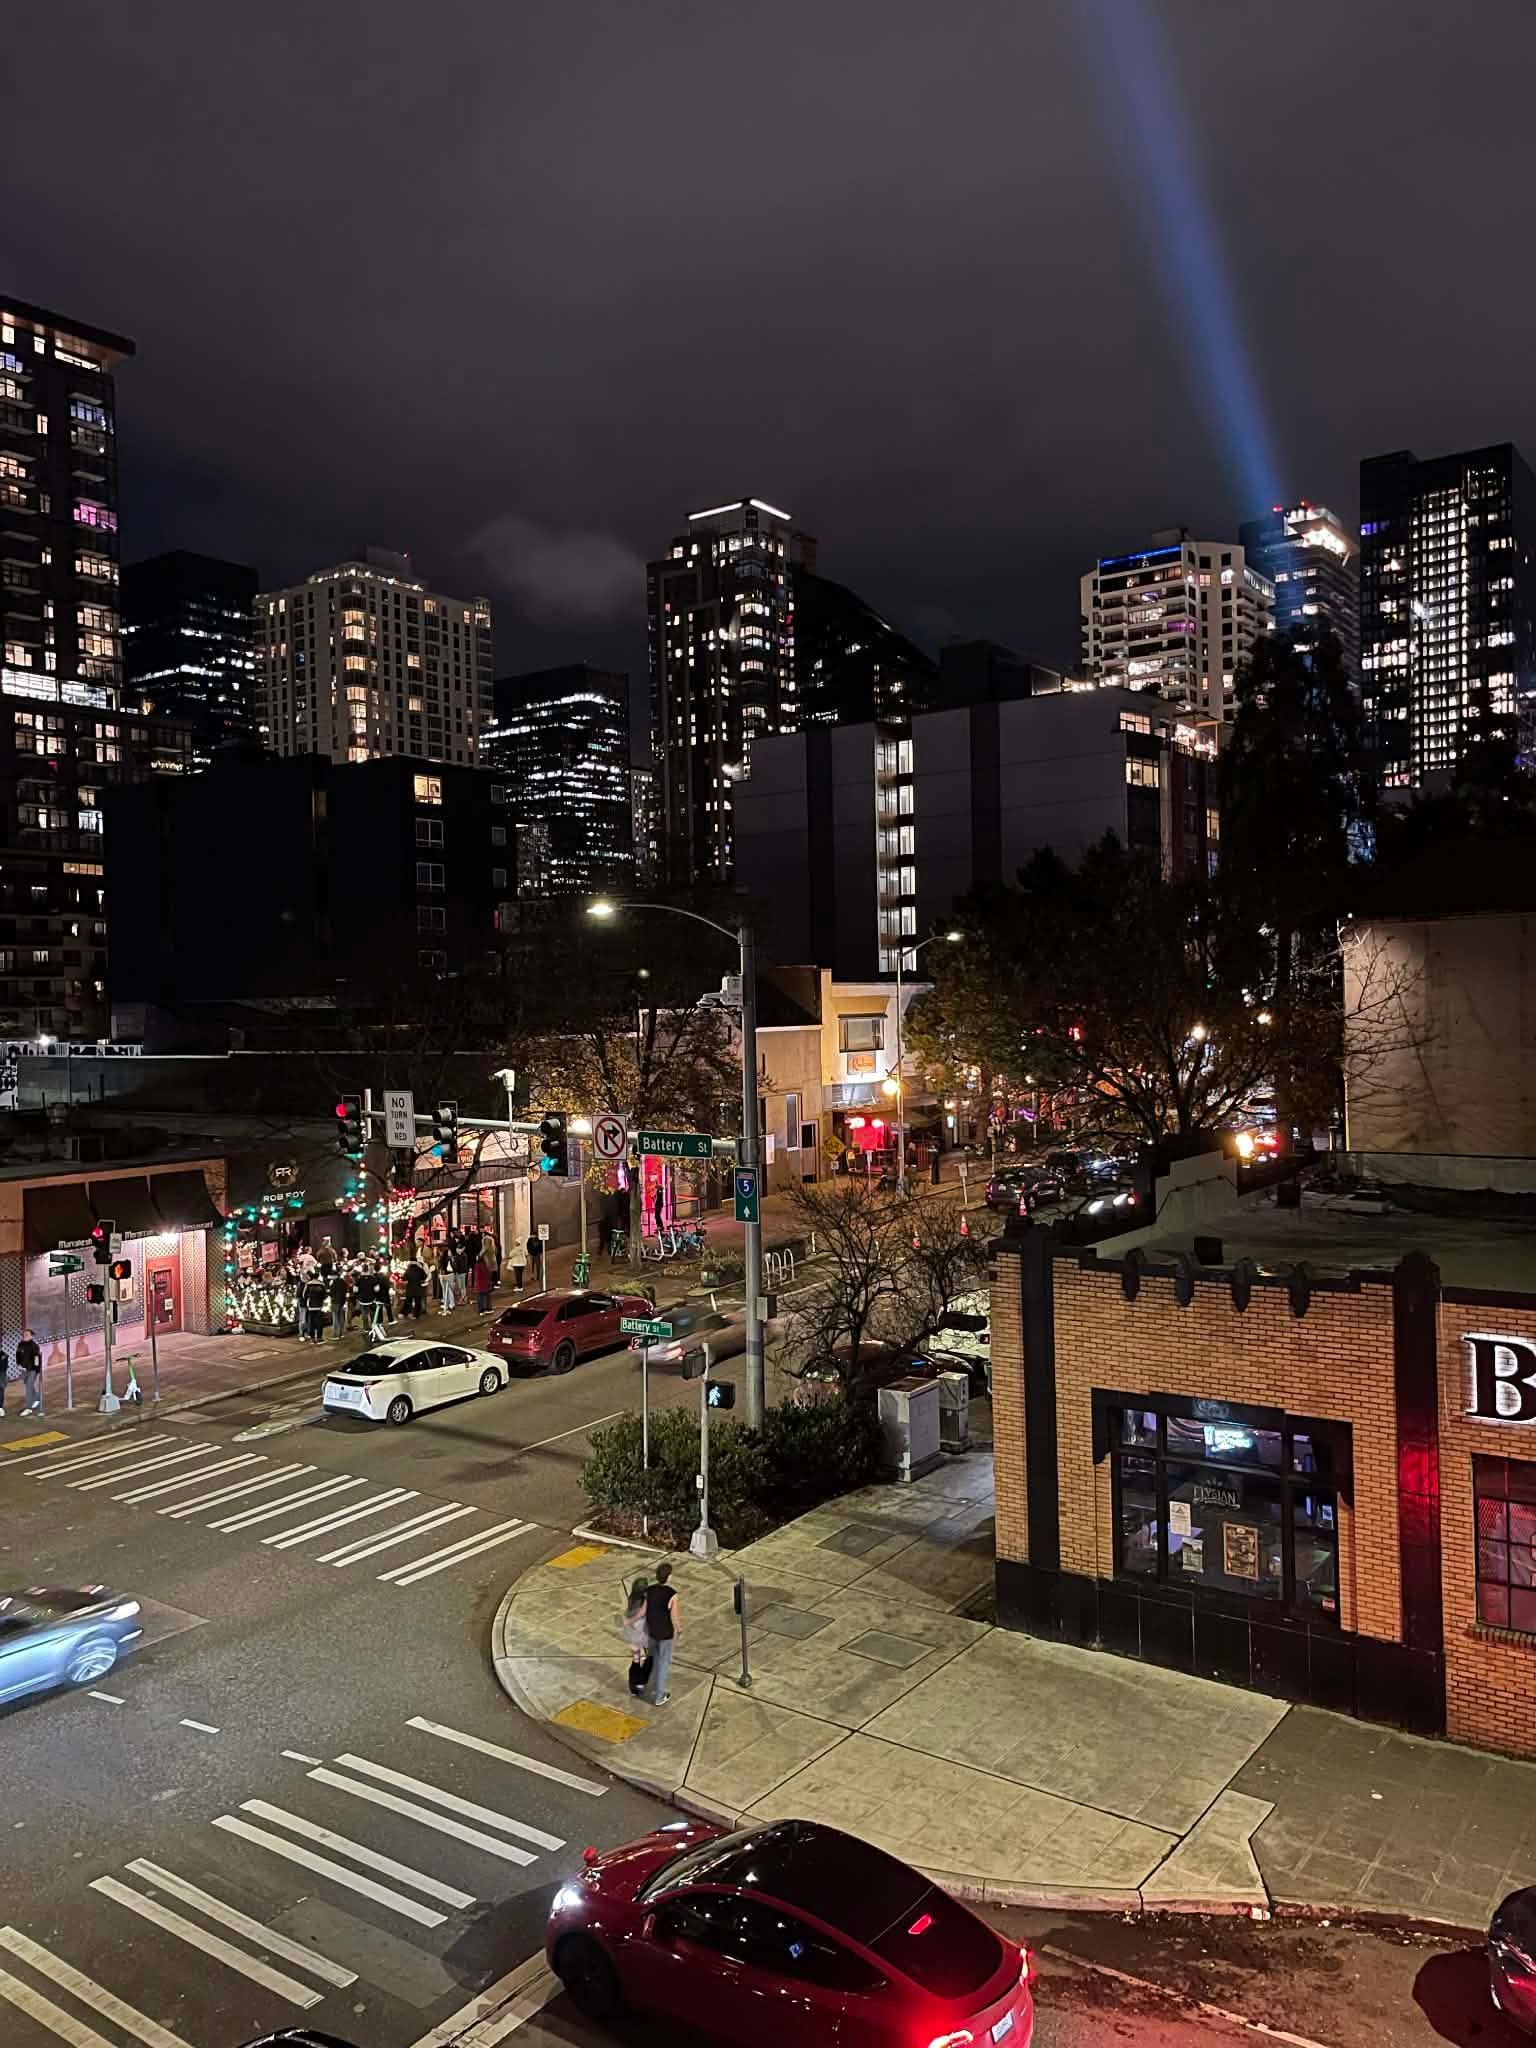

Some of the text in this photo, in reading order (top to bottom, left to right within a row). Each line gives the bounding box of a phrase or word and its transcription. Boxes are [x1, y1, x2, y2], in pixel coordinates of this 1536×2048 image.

[391, 1097, 405, 1108] NO
[391, 1110, 408, 1119] TURN
[395, 1121, 405, 1130] ON
[394, 1132, 408, 1141] RED
[643, 1136, 708, 1155] Battery St
[743, 1180, 750, 1192] 5
[263, 1190, 306, 1202] ROB ROY
[622, 1319, 650, 1334] Battery
